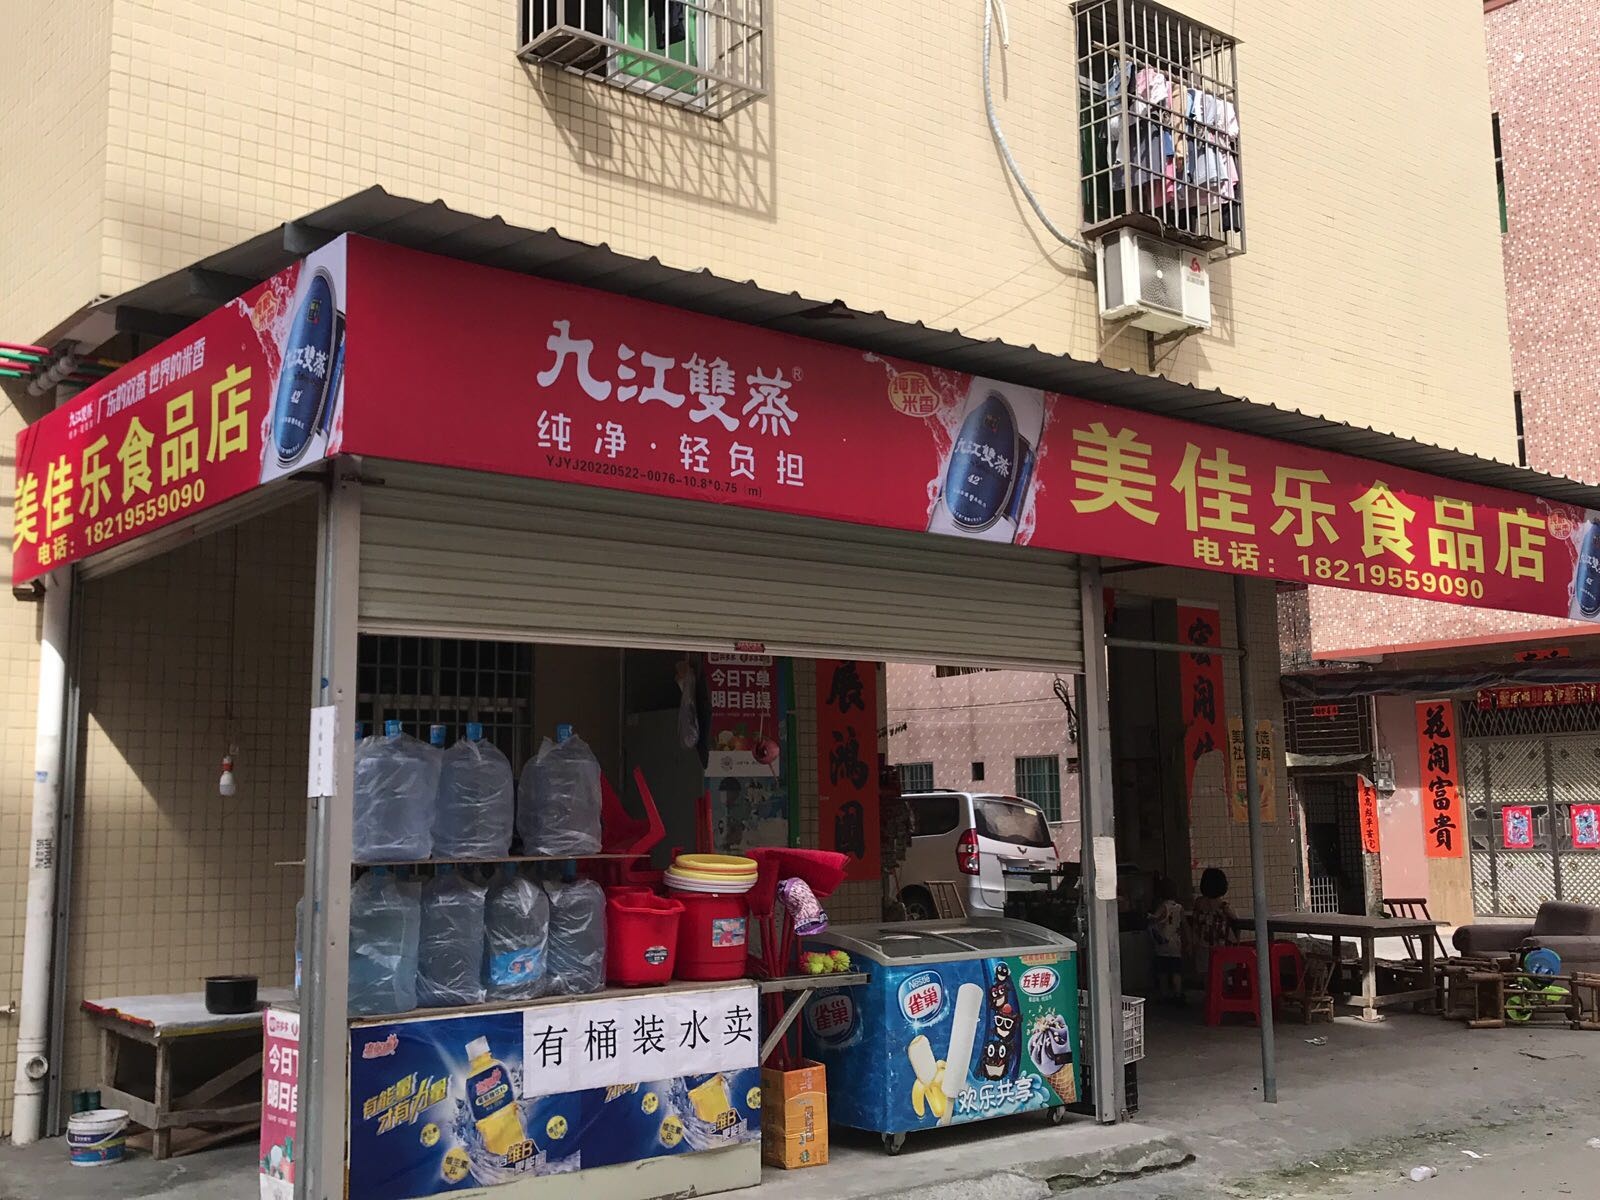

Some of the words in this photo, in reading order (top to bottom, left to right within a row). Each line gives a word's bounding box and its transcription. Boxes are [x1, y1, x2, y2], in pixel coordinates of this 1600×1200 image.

[536, 320, 799, 436] 九江雙蒸
[903, 395, 935, 414] 米香
[14, 364, 253, 552] 美佳乐食品店
[85, 479, 205, 546] 18219559090
[1069, 422, 1547, 583] 美佳乐食品店
[1297, 554, 1484, 600] 18219559090
[711, 668, 771, 689] 今日下单
[711, 690, 772, 714] 明日自提
[1022, 972, 1051, 989] 五羊牌
[814, 999, 849, 1031] 雀巢
[909, 986, 939, 1015] 雀巢
[533, 1004, 754, 1069] 有桶装水卖
[958, 1076, 1034, 1113] 欢乐共享
